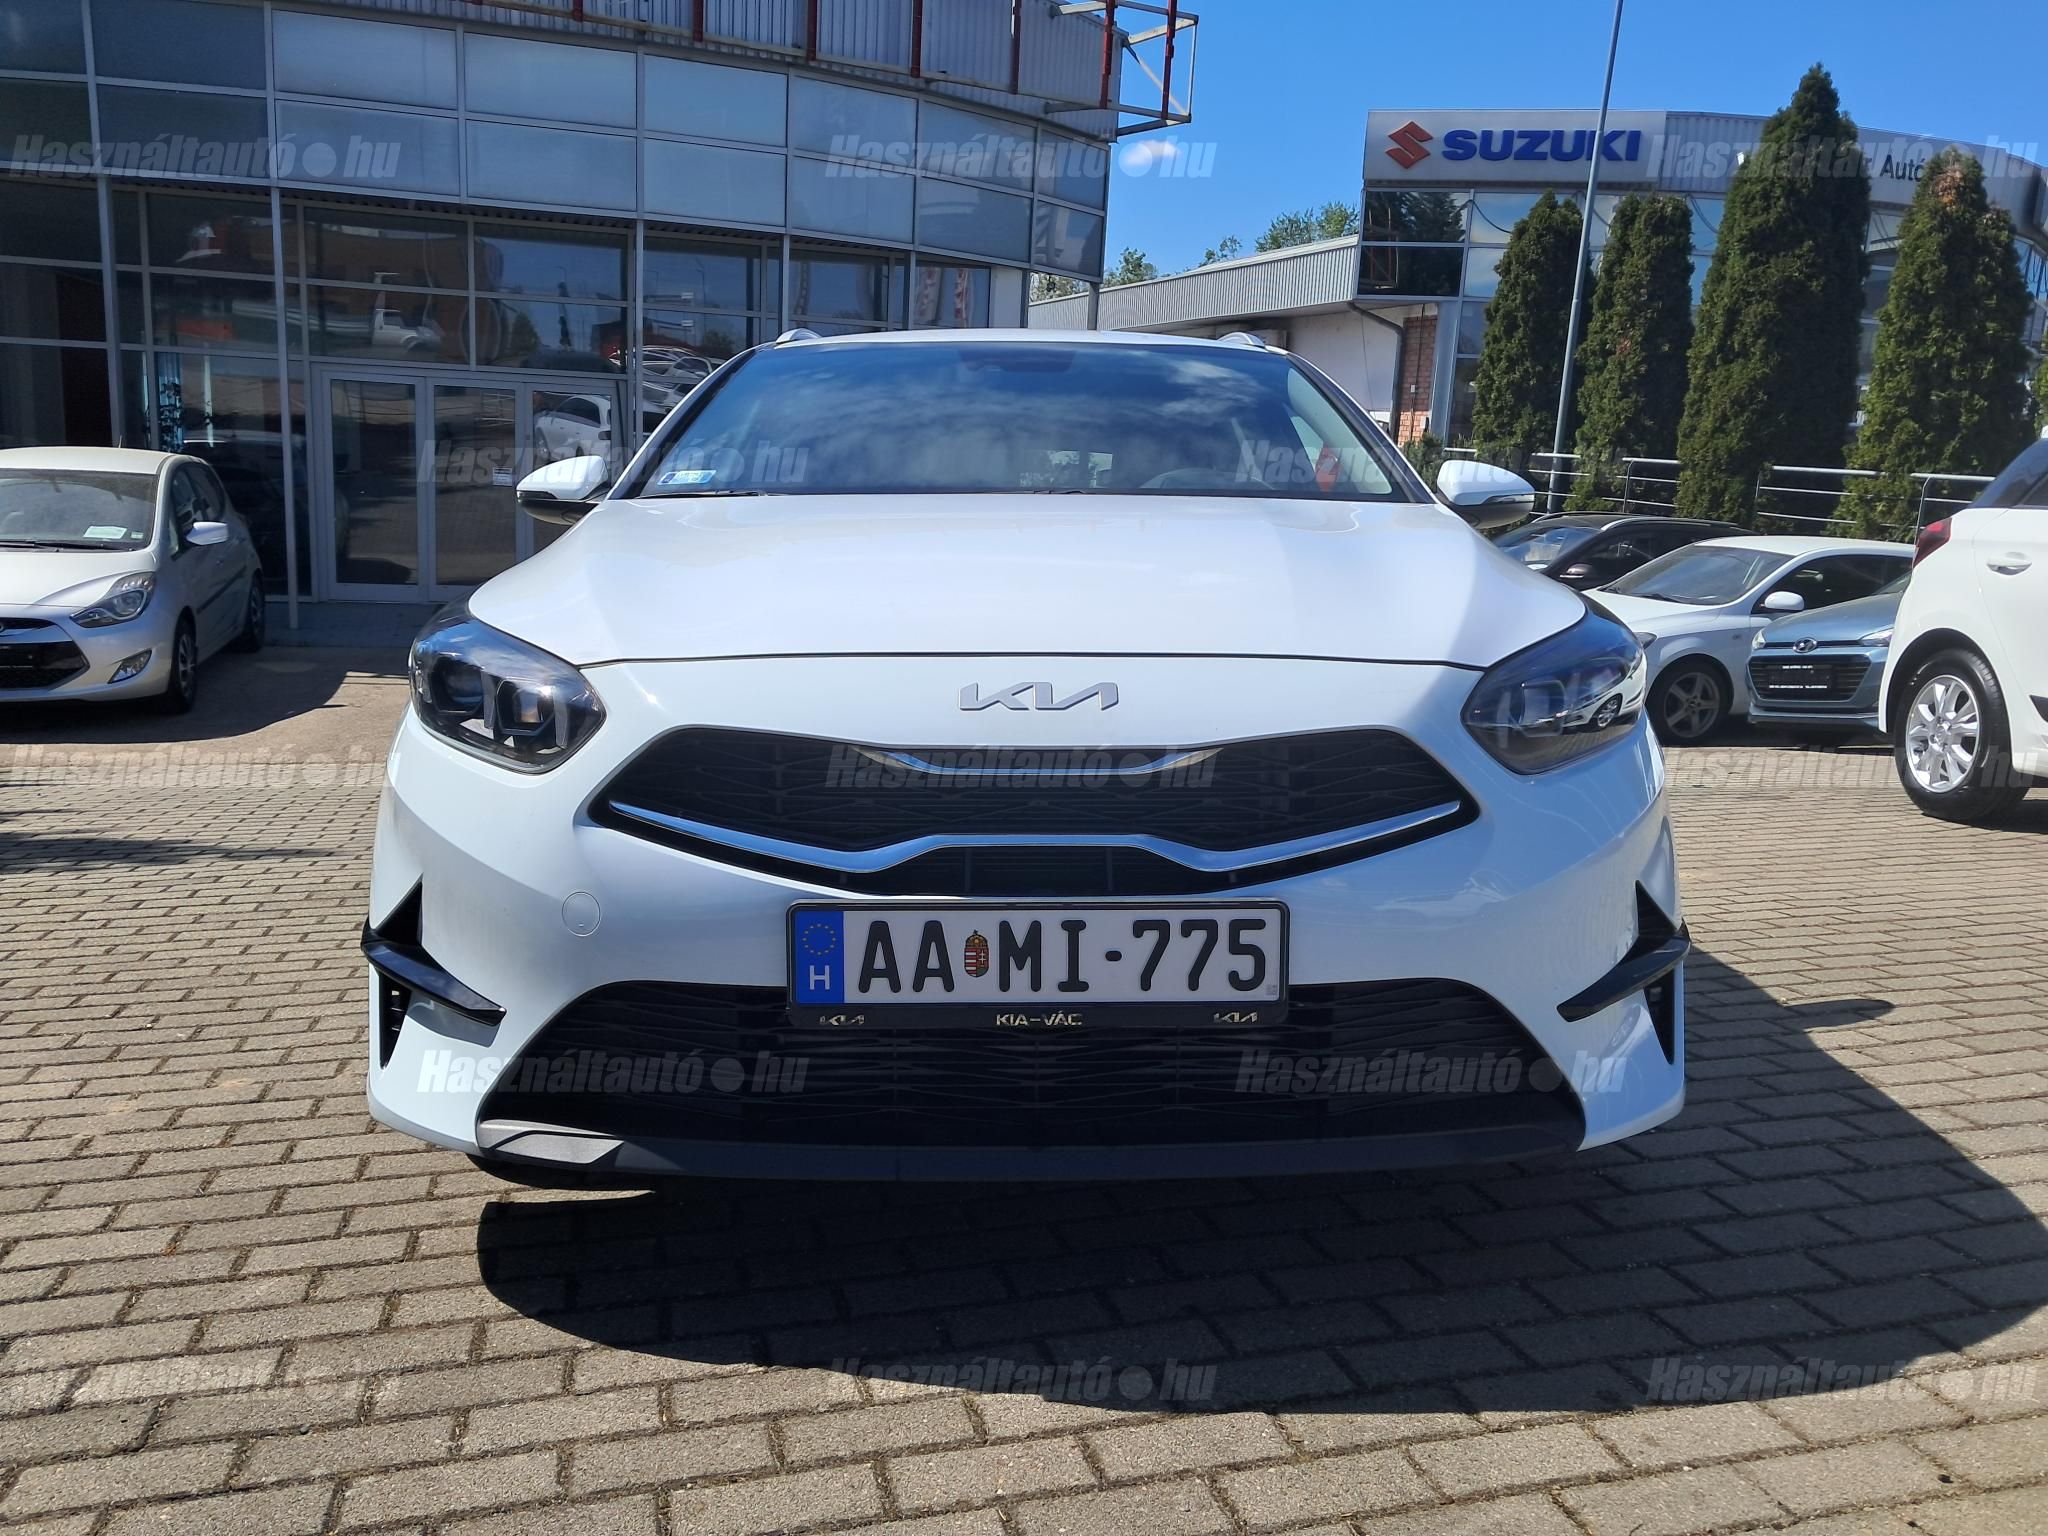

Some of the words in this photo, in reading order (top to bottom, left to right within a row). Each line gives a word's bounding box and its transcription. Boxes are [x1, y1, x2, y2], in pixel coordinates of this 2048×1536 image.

[1442, 130, 1642, 162] SUZUKI
[958, 681, 1119, 711] KIA
[809, 965, 831, 991] H
[858, 920, 955, 993] AA
[999, 918, 1267, 992] MI-775
